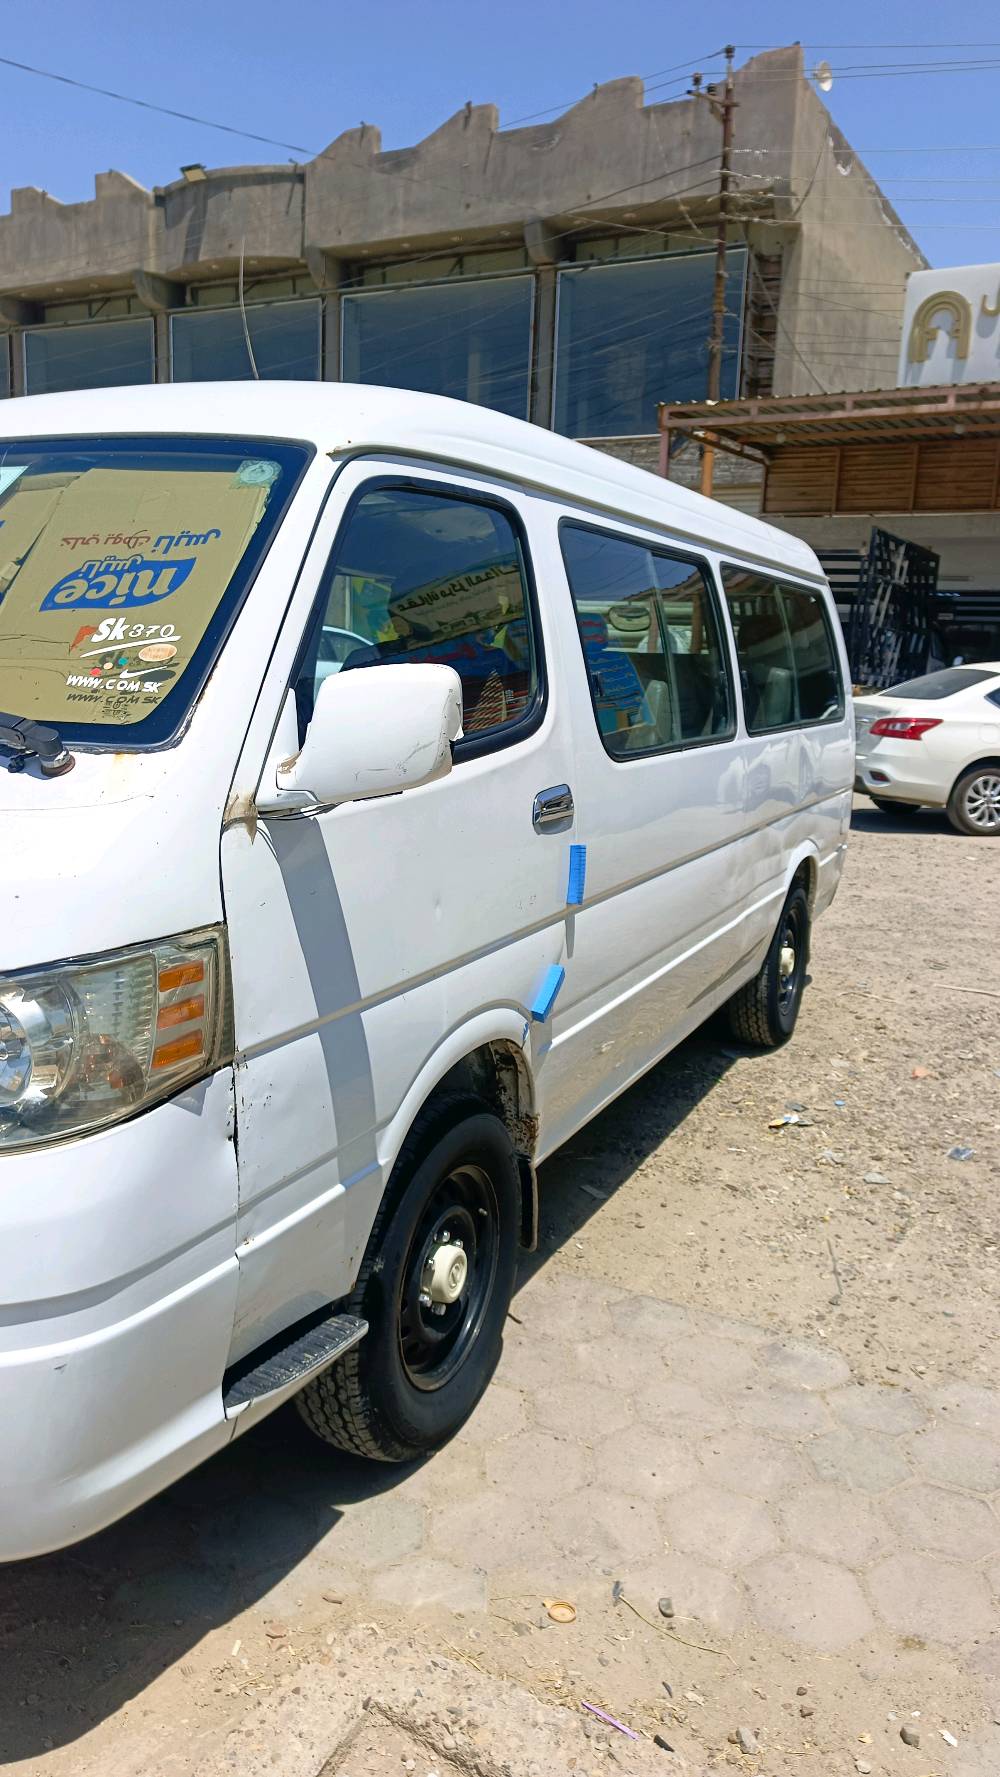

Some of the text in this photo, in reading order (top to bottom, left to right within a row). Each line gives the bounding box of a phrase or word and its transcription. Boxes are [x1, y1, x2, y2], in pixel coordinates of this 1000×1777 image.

[61, 528, 222, 555] خلي يومك نايس
[79, 554, 144, 578] نايس
[53, 567, 177, 606] nice
